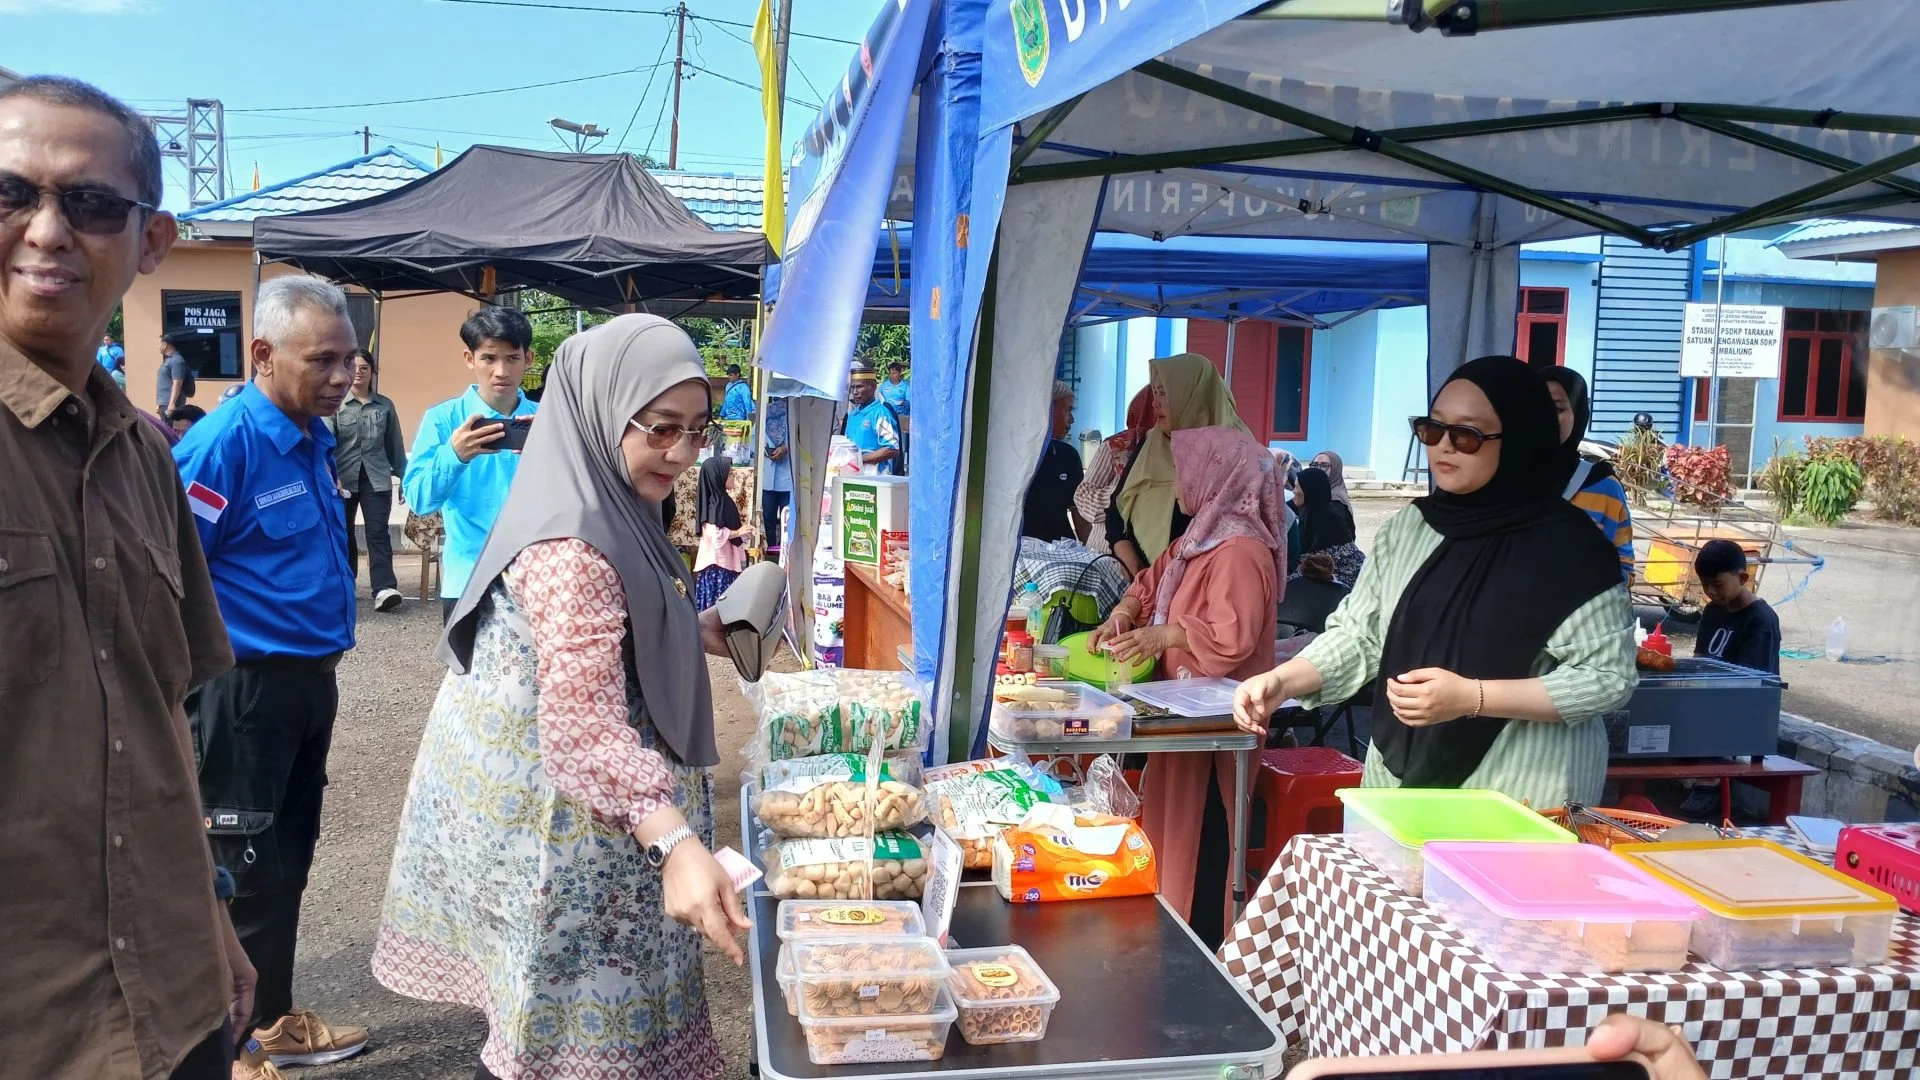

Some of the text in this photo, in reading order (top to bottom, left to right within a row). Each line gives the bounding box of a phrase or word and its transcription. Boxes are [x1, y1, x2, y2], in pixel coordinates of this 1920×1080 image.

[184, 307, 227, 317] POS JAGA
[184, 317, 227, 327] PELAYANAN
[1691, 326, 1774, 337] STASIU PSDKP TARAKAN
[1686, 336, 1777, 347] SATUAN ENGAWASAN SDKP
[1710, 347, 1753, 356] SMBALIUNG
[1025, 892, 1040, 900] 250
